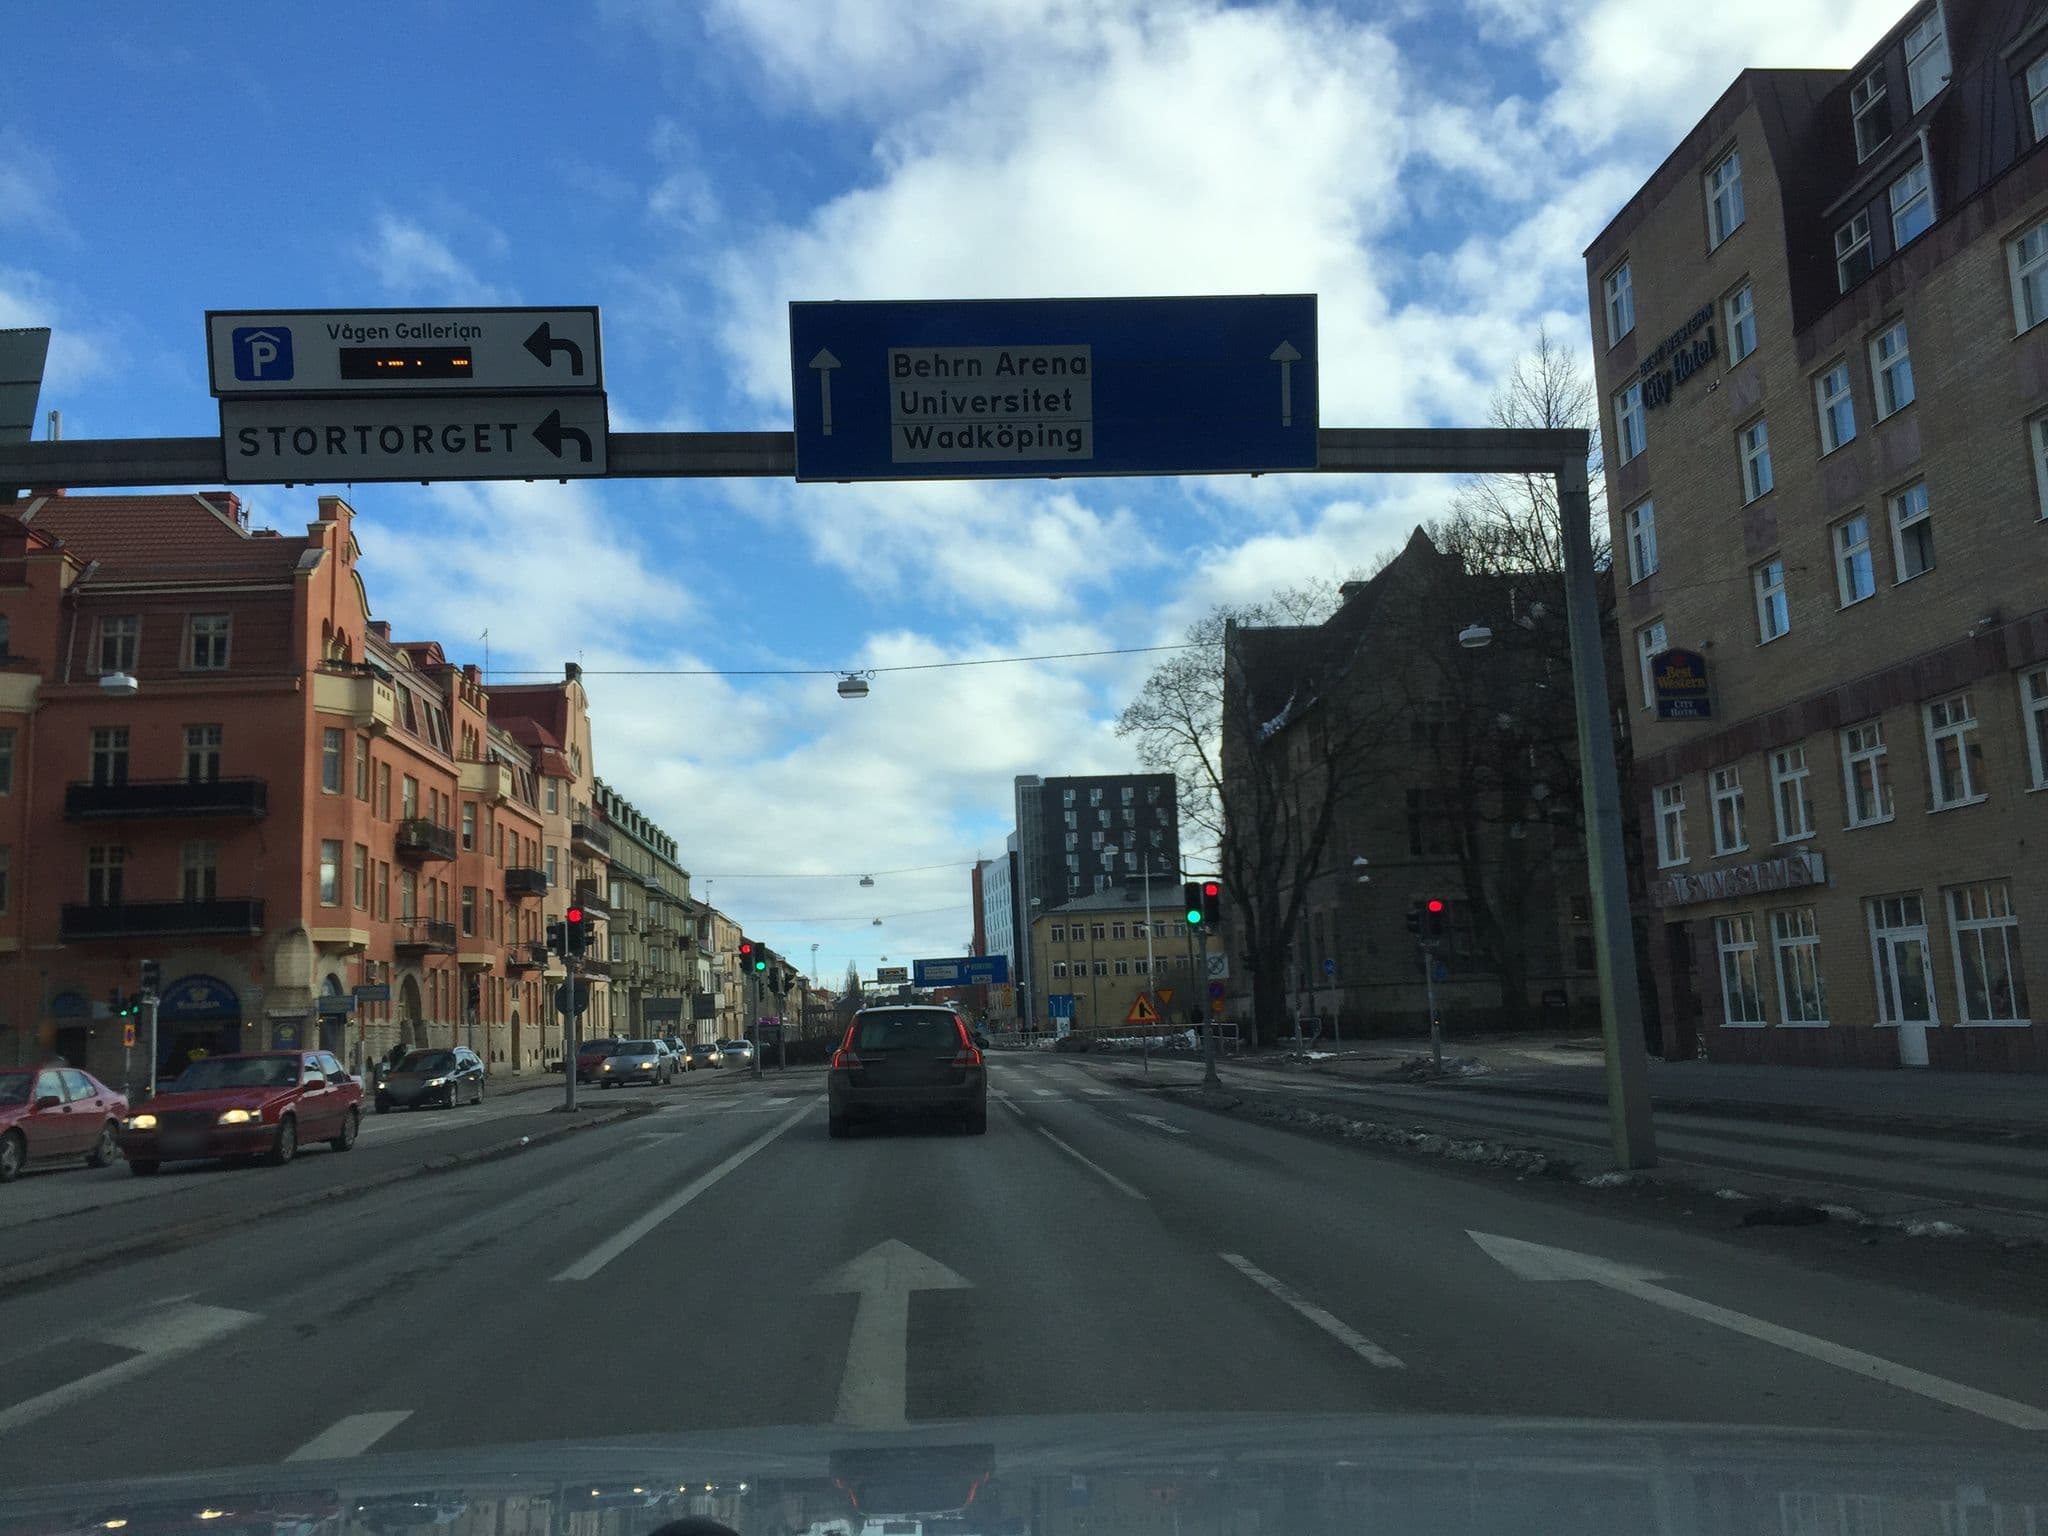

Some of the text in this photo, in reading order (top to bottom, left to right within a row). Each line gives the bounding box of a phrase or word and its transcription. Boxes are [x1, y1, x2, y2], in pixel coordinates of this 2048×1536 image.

[326, 322, 482, 343] Vågen Gallerian
[250, 341, 278, 377] P
[893, 351, 1087, 378] Behrn Arena
[1673, 325, 1715, 385] Hotel
[900, 387, 1072, 415] Universitet
[238, 423, 518, 457] STORTORGET
[902, 423, 1083, 454] Wadköping
